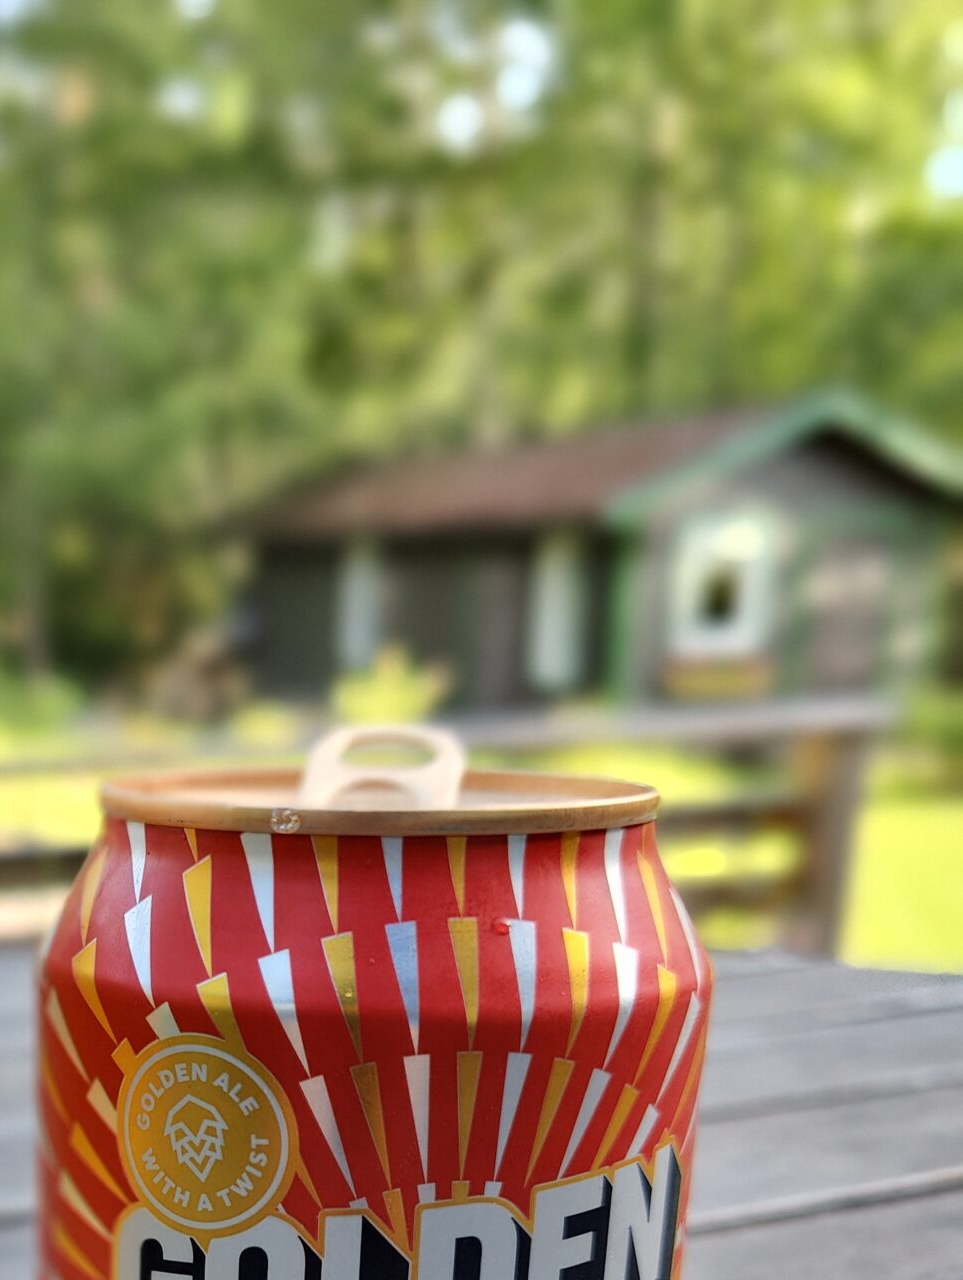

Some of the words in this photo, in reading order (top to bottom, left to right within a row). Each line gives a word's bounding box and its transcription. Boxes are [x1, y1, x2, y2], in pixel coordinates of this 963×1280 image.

[137, 1062, 208, 1131] GOLDEN
[212, 1071, 261, 1117] ALE
[141, 1147, 191, 1208] WITH
[197, 1193, 214, 1212] A
[216, 1134, 270, 1208] TWIST
